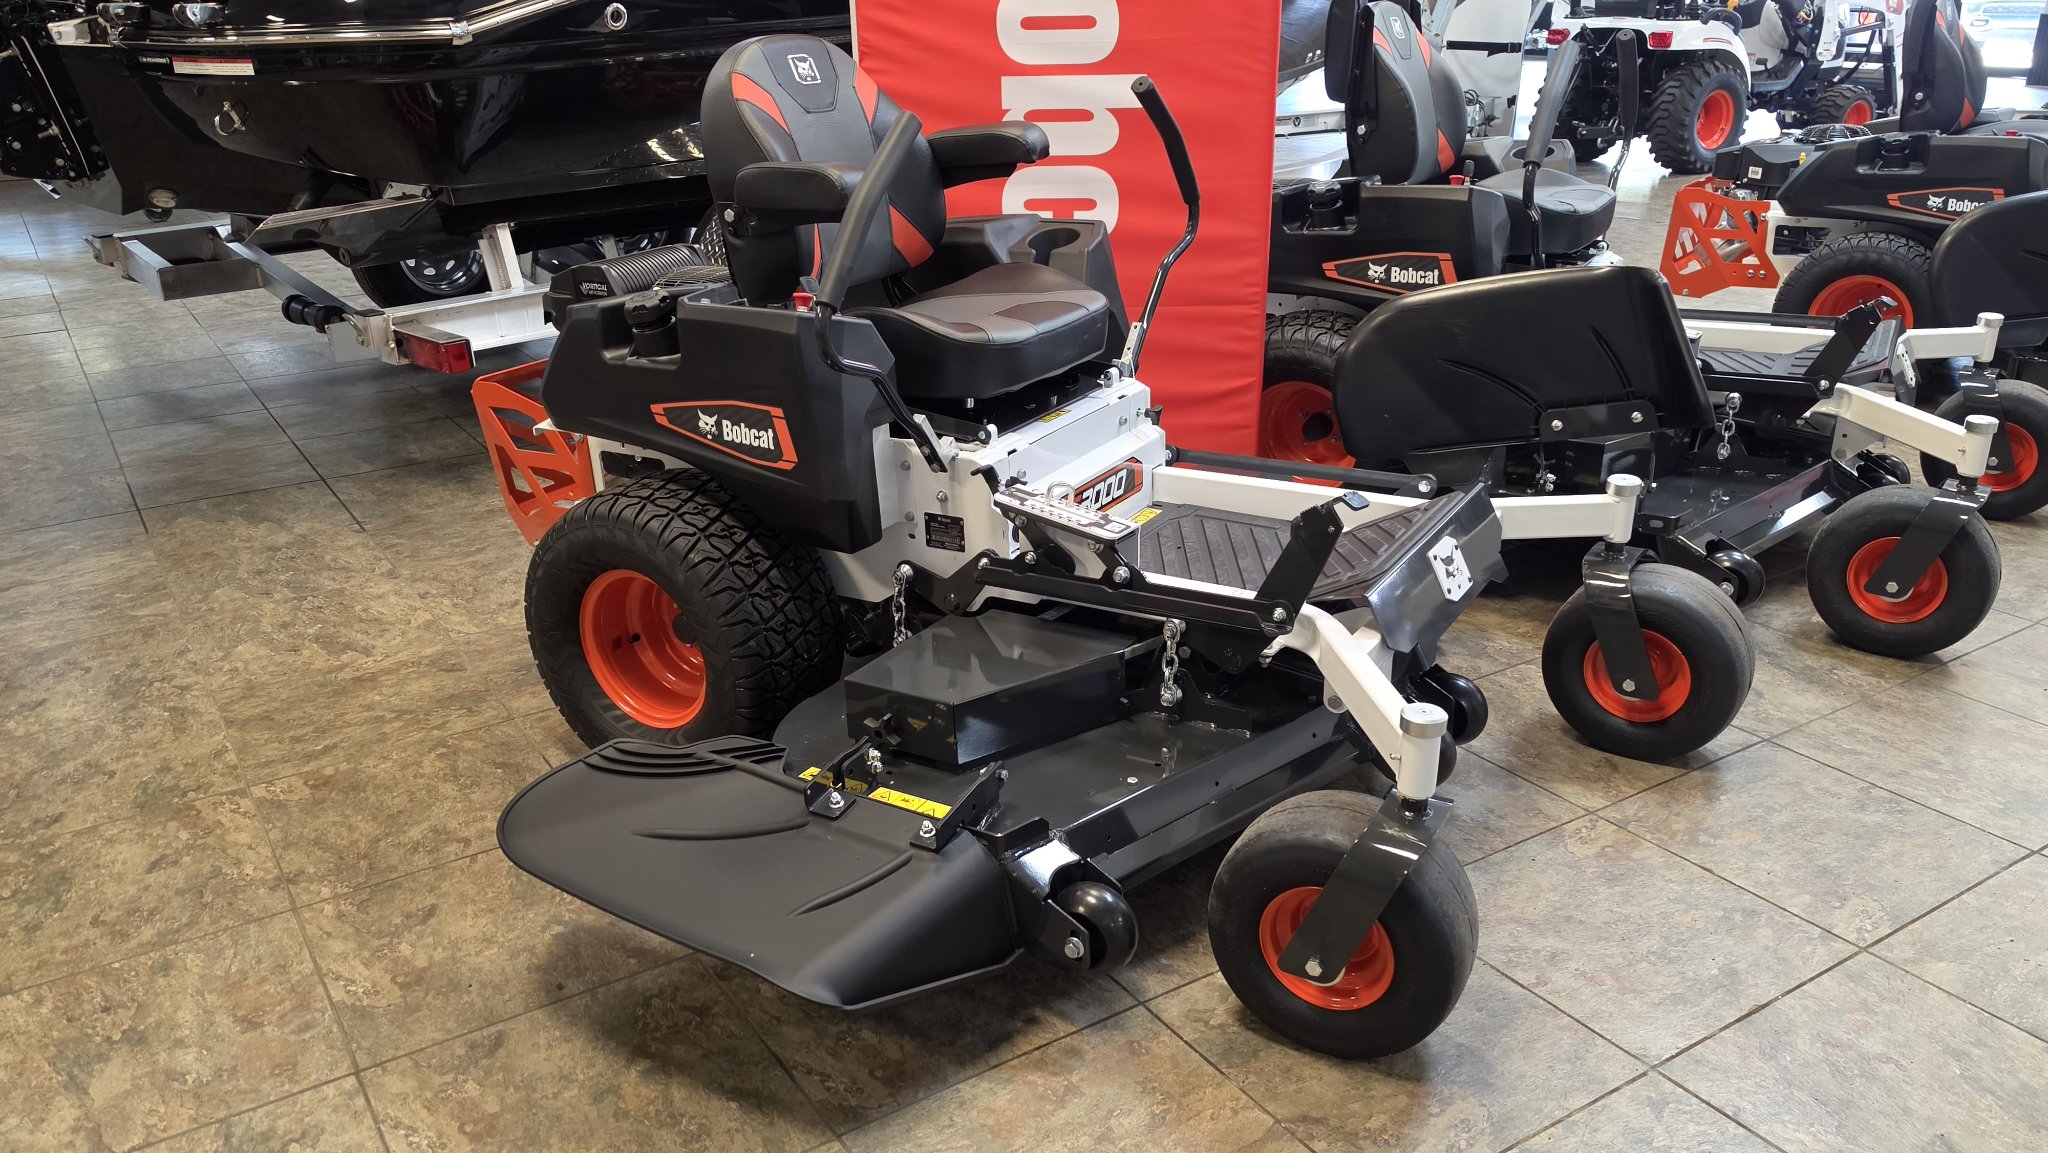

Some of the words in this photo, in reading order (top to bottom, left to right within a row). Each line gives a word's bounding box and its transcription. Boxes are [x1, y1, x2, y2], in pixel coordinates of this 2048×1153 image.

[1947, 198, 1988, 212] Bobc
[1390, 266, 1439, 285] Bobcat
[721, 419, 775, 450] Bobcat
